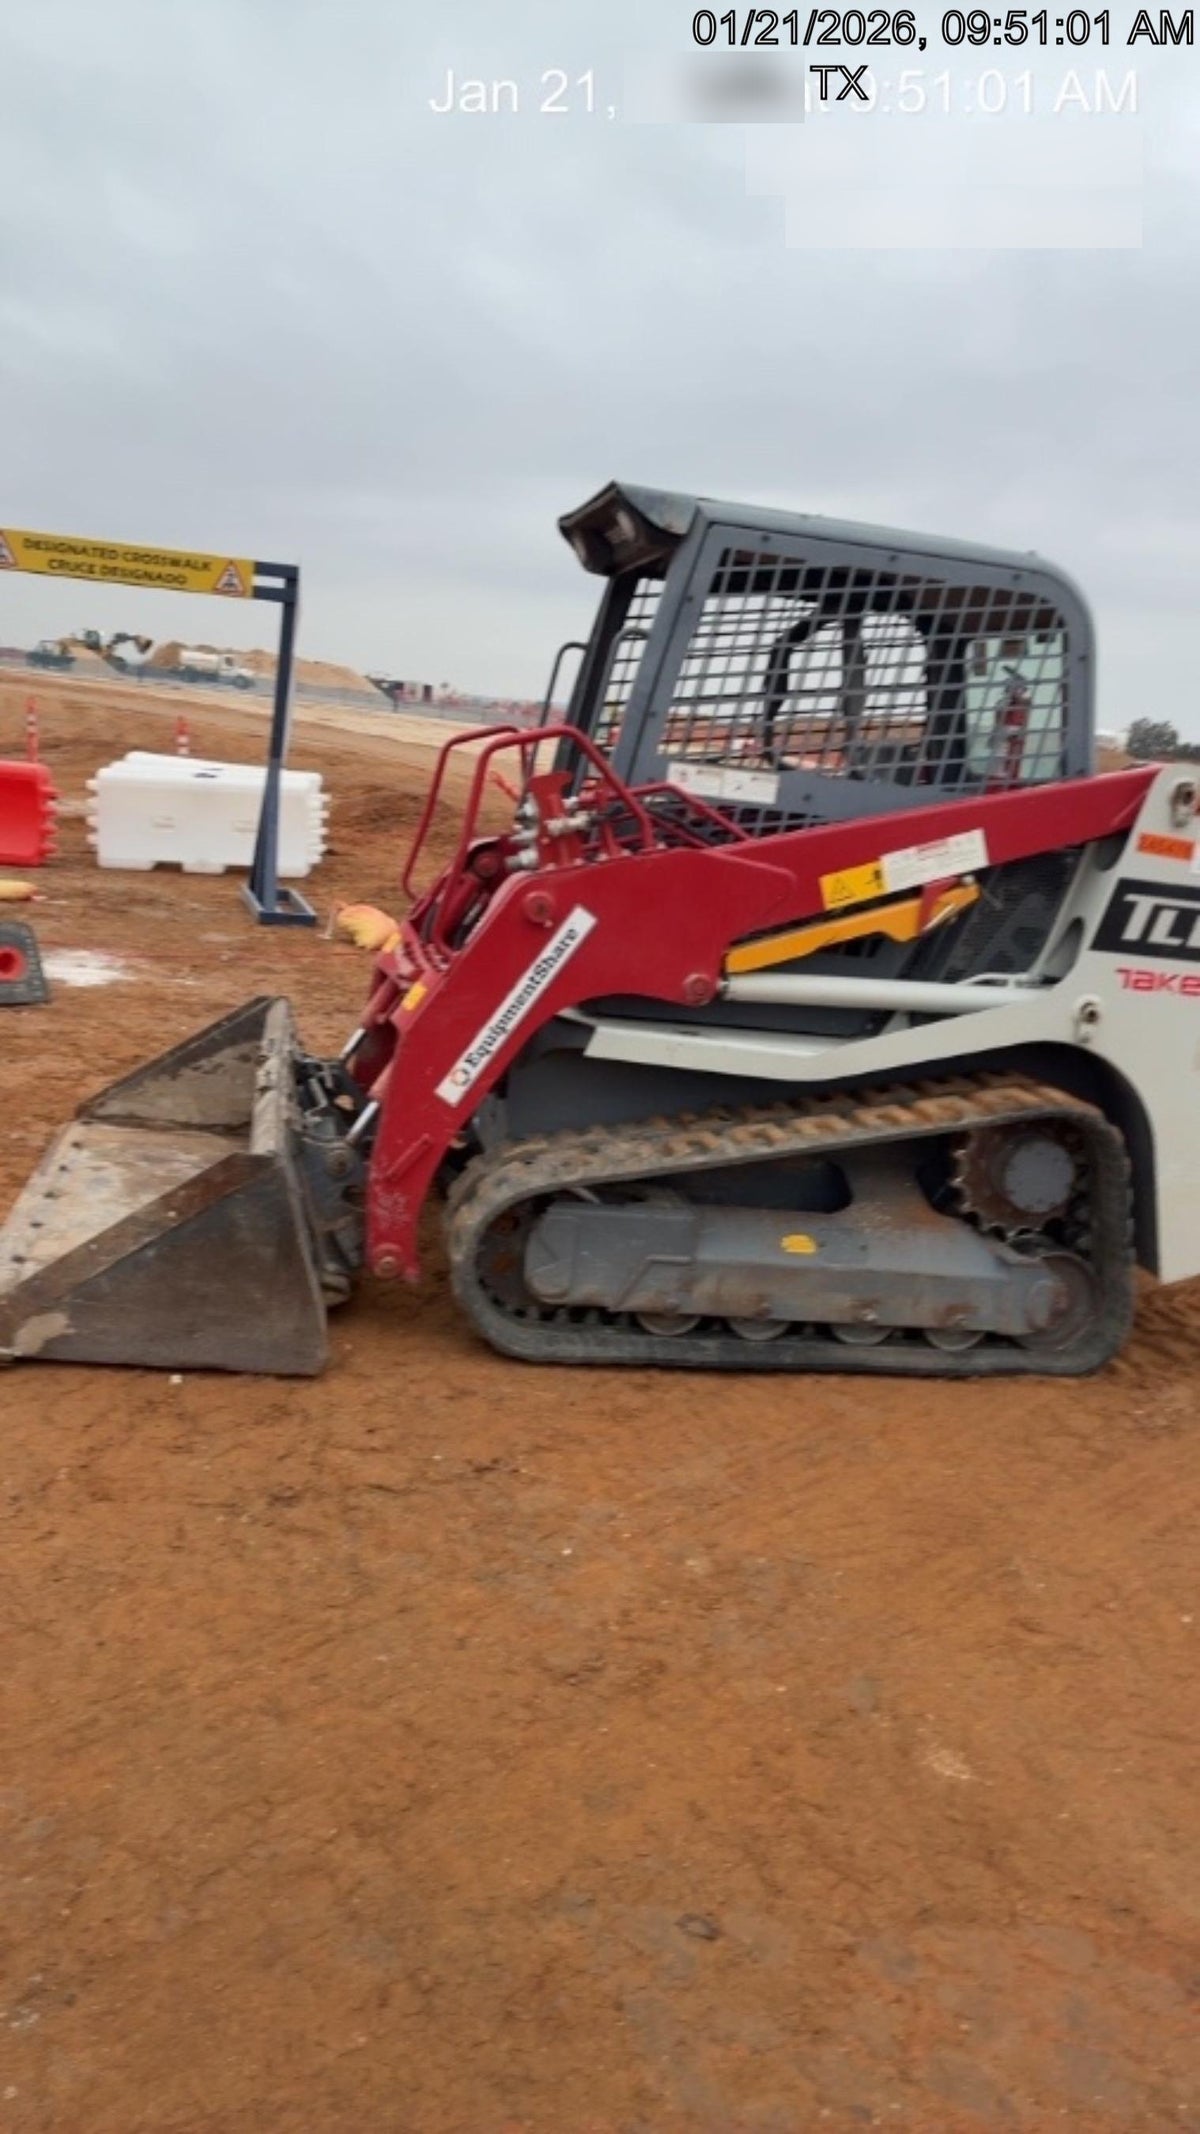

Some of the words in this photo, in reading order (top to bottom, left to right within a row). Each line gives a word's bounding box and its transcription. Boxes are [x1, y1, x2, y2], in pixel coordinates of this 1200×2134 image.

[22, 537, 118, 560] DESIGNATED
[121, 551, 212, 572] CROSSWALK
[47, 558, 96, 575] CRUCE
[100, 564, 188, 585] DESIGNADO
[464, 927, 578, 1069] EquipmentShare
